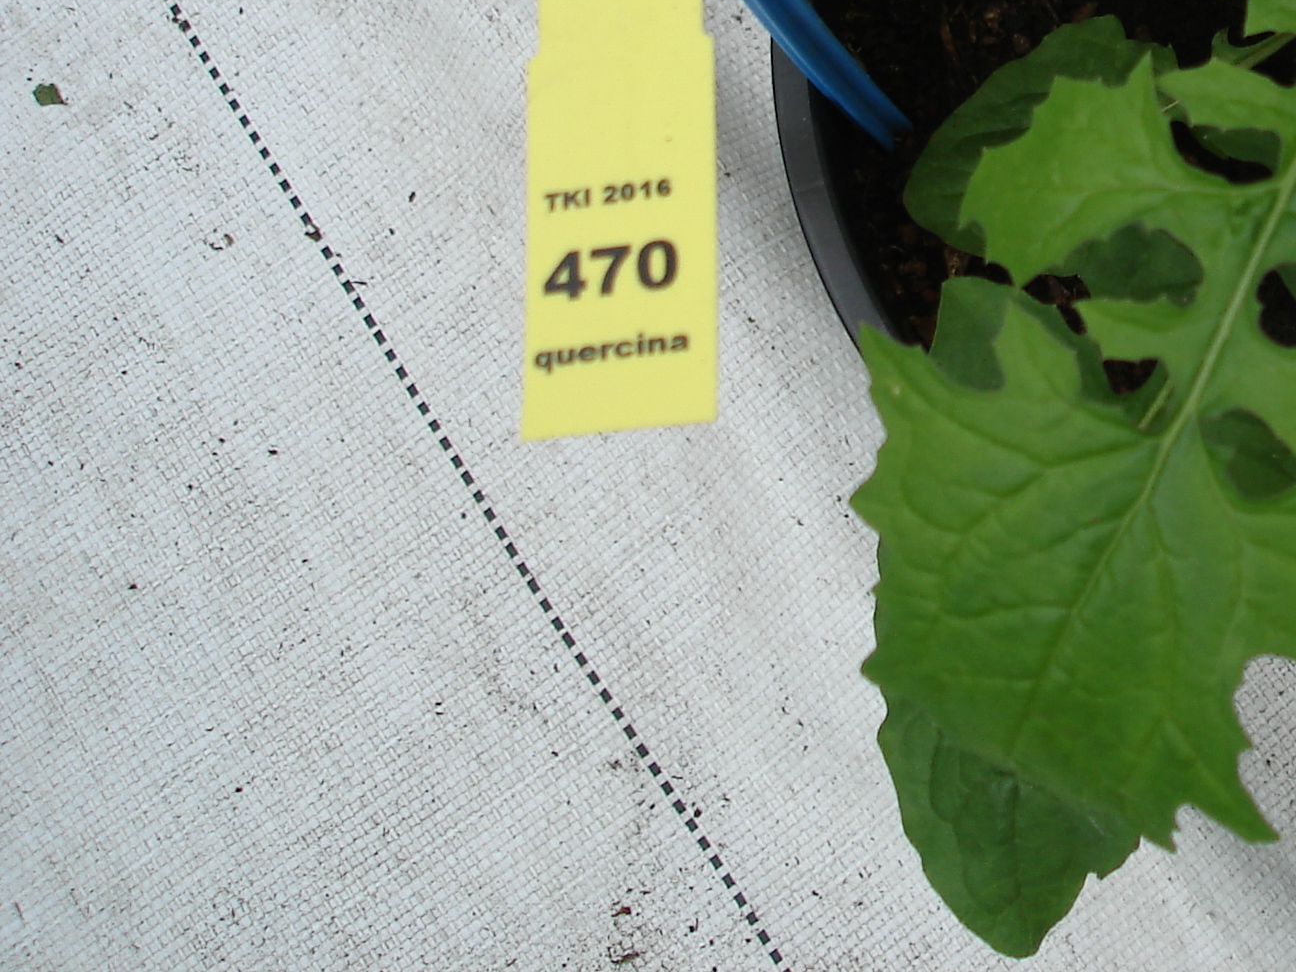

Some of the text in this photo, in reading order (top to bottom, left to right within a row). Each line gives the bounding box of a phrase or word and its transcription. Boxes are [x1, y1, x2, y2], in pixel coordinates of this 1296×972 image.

[545, 177, 672, 212] TKI 2016
[543, 239, 679, 301] 470
[534, 332, 689, 375] quercina
